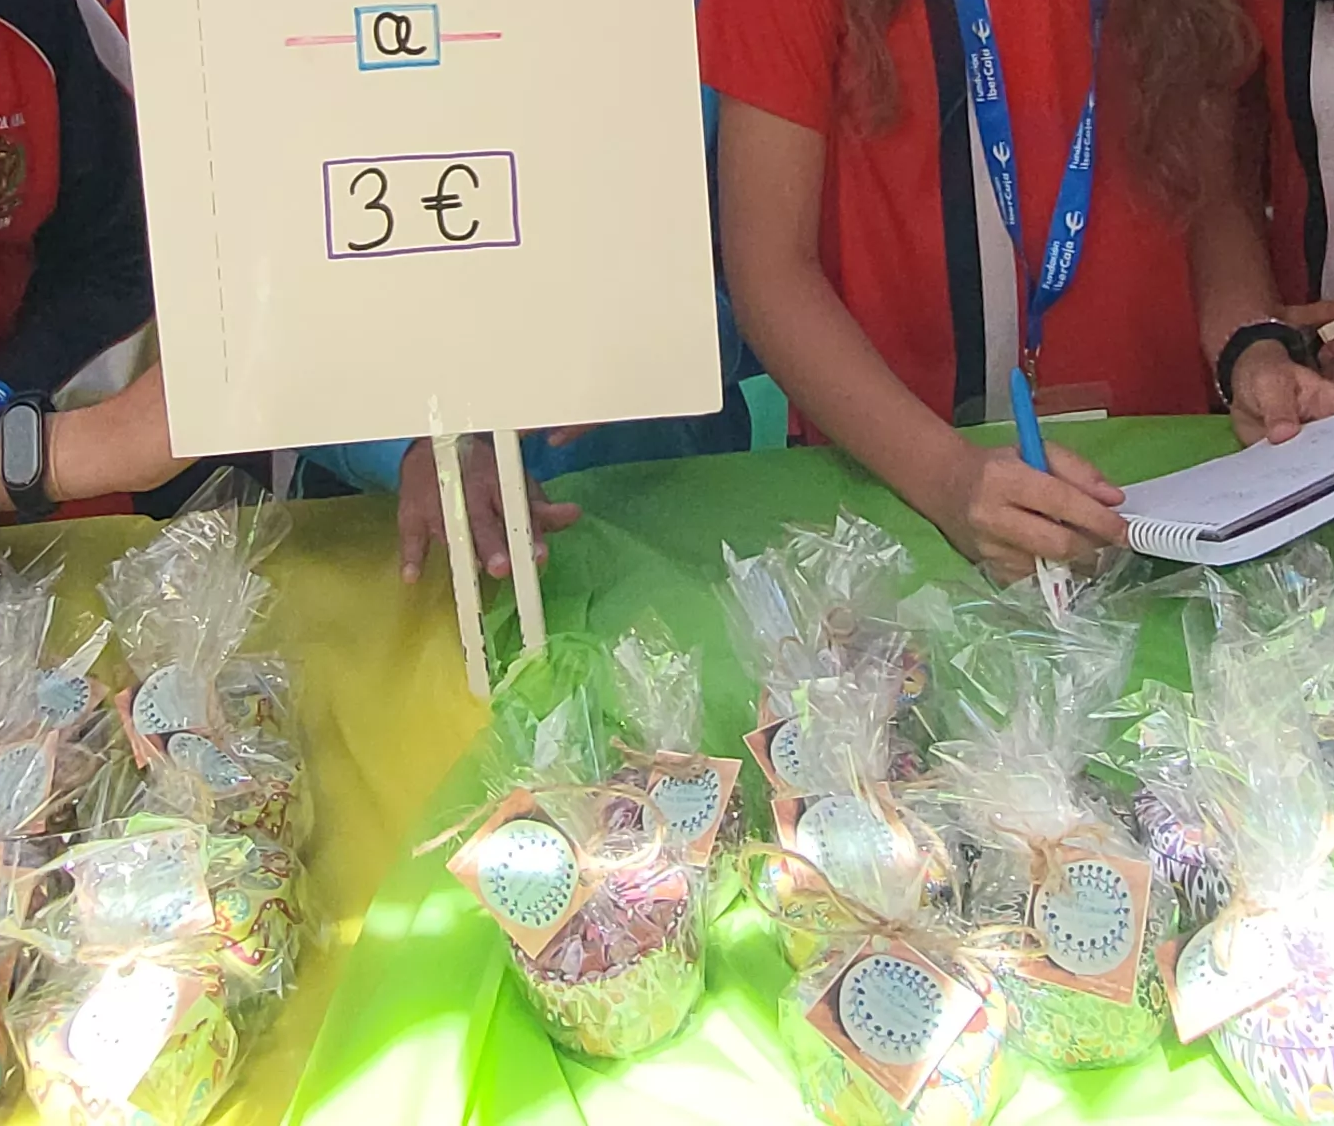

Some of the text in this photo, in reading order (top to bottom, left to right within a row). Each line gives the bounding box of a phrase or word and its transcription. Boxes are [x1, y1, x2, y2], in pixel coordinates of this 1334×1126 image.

[373, 11, 427, 57] a
[348, 163, 480, 252] 3 €
